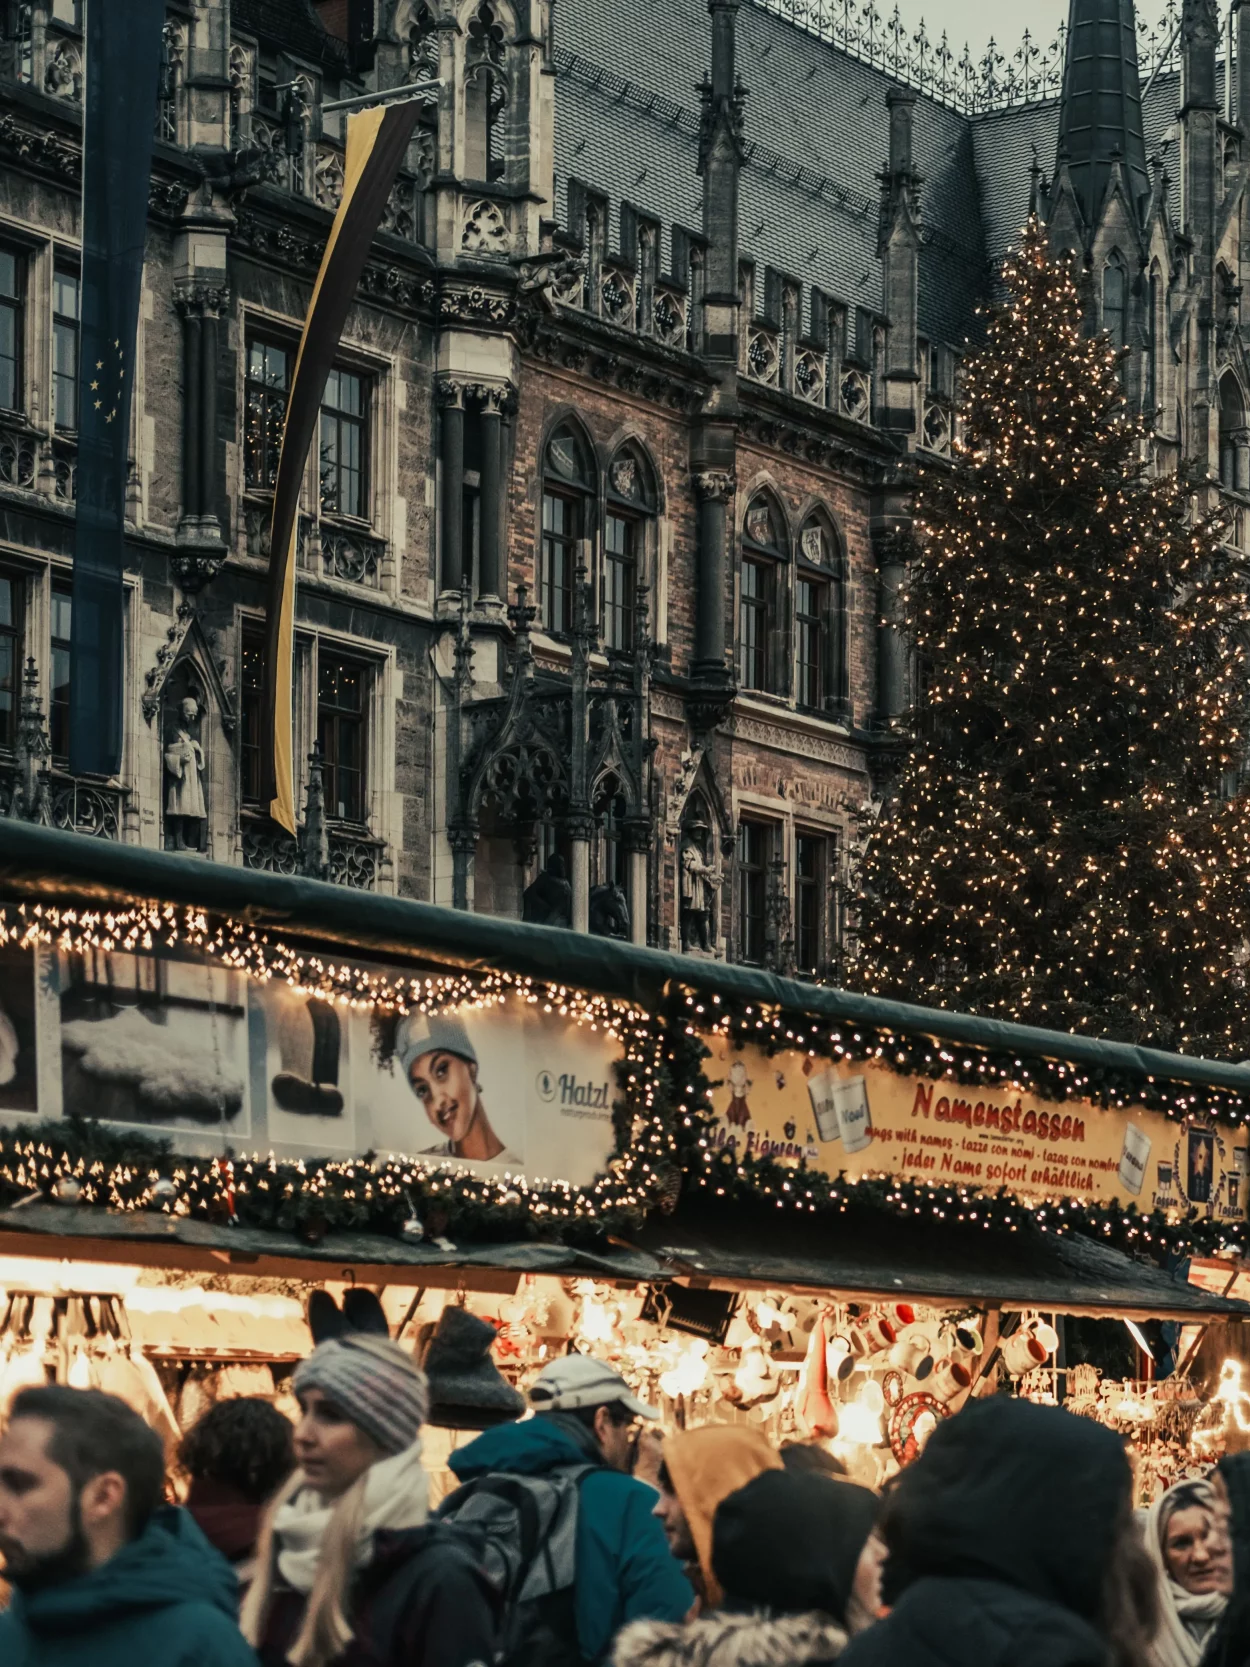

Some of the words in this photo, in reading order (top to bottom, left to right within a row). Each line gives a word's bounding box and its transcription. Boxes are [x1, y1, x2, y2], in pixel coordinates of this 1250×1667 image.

[558, 1073, 609, 1110] Hatzl
[911, 1082, 1085, 1142] Namenstassen
[895, 1128, 917, 1143] with
[920, 1135, 953, 1150] names
[991, 1143, 1008, 1156] con
[1011, 1146, 1035, 1161] nomi
[1043, 1148, 1069, 1167] tazas
[1071, 1155, 1087, 1168] con
[901, 1147, 936, 1170] jeder
[940, 1152, 982, 1178] Name
[986, 1161, 1028, 1184] sofort
[1030, 1165, 1094, 1192] erhältlich
